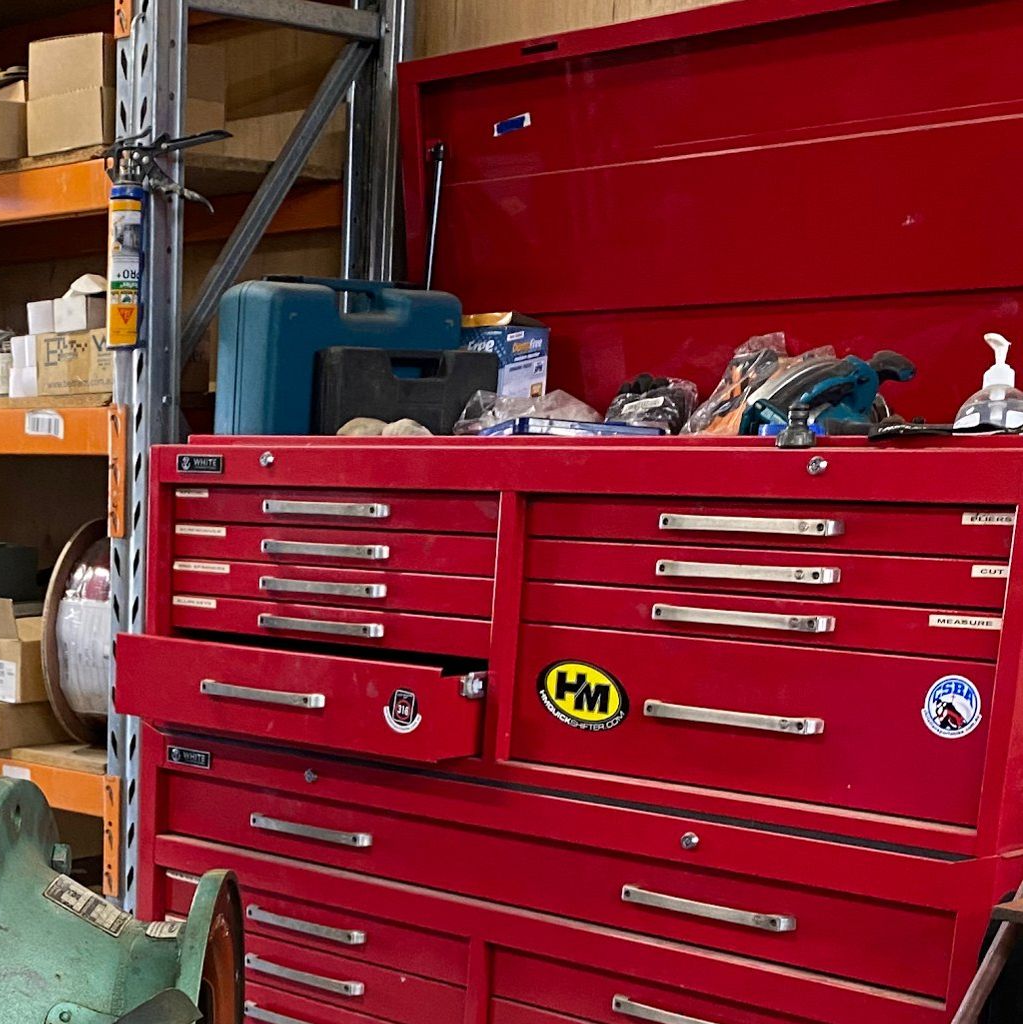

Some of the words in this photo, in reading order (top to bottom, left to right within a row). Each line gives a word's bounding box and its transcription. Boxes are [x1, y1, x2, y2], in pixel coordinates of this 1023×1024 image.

[193, 457, 217, 467] WHITE
[937, 618, 993, 627] MEASURE
[397, 704, 409, 716] 316
[182, 751, 206, 763] WHITE
